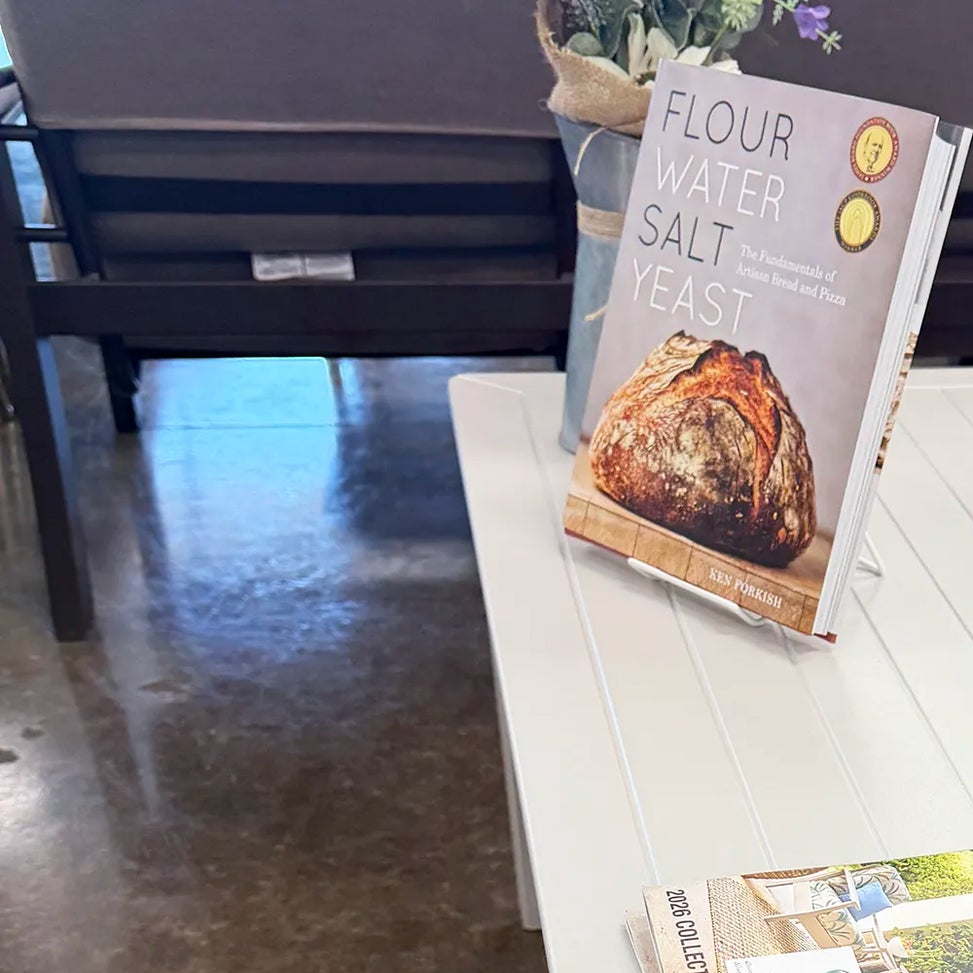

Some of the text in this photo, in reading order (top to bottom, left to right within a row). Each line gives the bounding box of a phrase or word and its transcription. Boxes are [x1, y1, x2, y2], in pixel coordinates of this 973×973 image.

[662, 90, 793, 160] FLOUR
[656, 147, 785, 222] WATER
[638, 203, 734, 266] SALT
[736, 262, 846, 306] Artisan Bread and Pizza
[741, 244, 838, 283] The Fundamentals of
[633, 258, 752, 335] YEAST
[709, 568, 783, 609] KEN FORKISH
[666, 889, 691, 918] 2026
